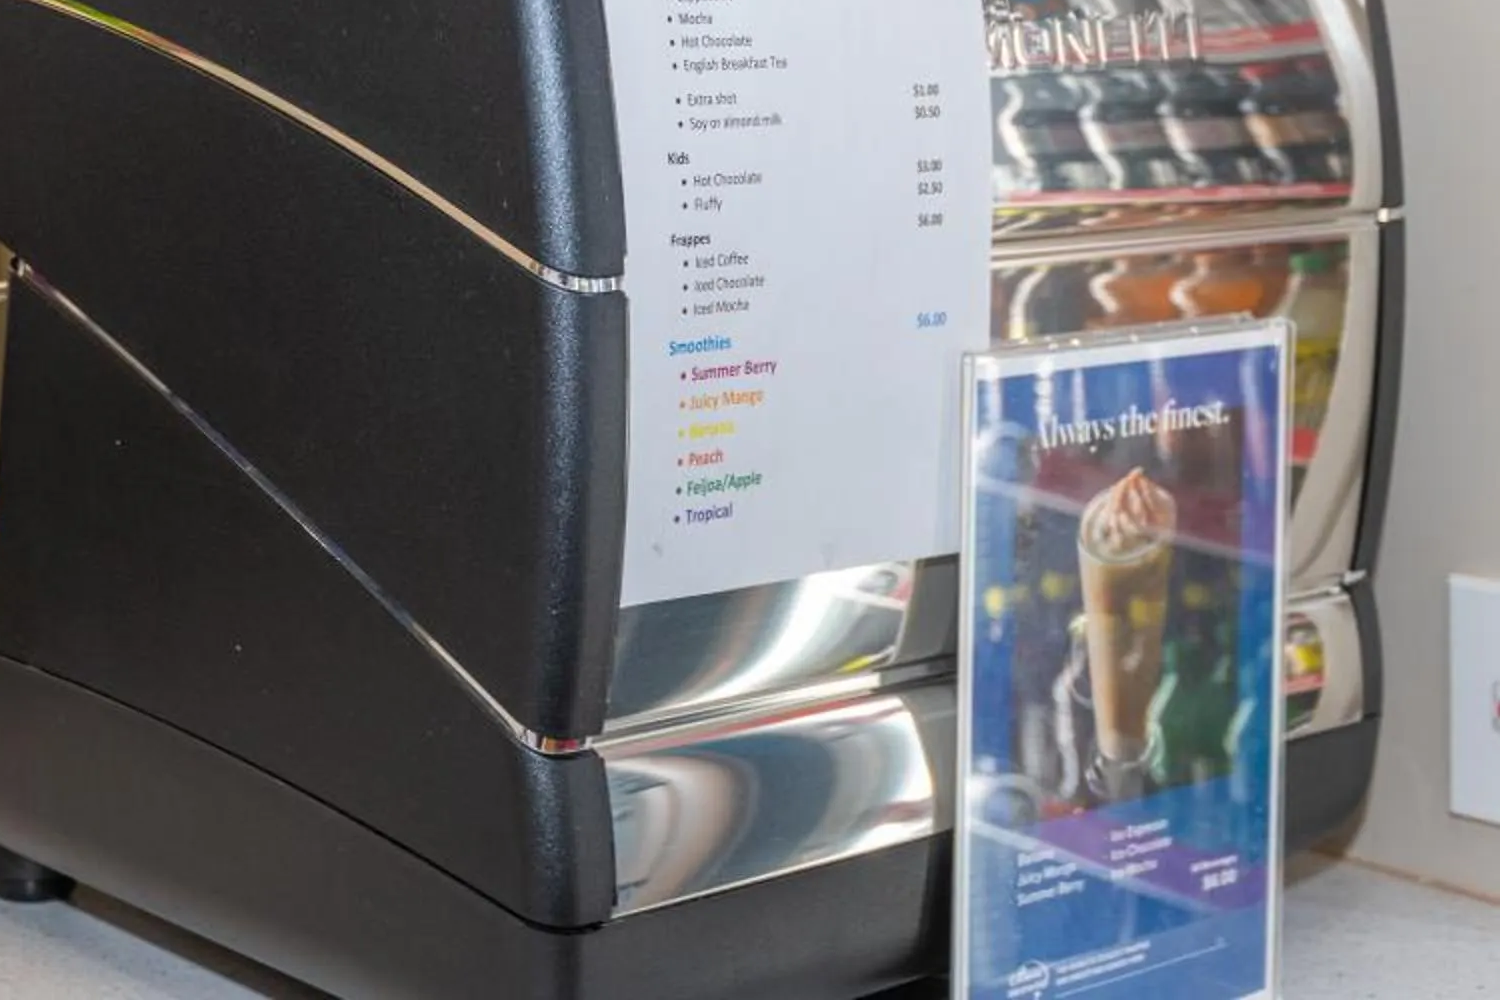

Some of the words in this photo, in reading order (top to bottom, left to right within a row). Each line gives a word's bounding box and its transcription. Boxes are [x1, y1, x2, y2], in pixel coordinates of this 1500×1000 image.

[678, 12, 713, 25] Mocha
[681, 35, 699, 48] Hot
[702, 34, 753, 48] Chocolate
[683, 58, 719, 75] English
[721, 56, 769, 71] Breakfast
[770, 55, 788, 69] Tea
[687, 93, 713, 106] Extra
[715, 92, 737, 105] shot
[689, 117, 708, 131] Soy
[723, 115, 760, 128] almond
[762, 112, 783, 126] milk
[667, 152, 690, 165] Kids
[693, 174, 711, 187] Hot
[713, 170, 763, 187] Chocolate
[694, 196, 723, 212] Fluffy
[670, 233, 711, 248] Frappes
[695, 255, 715, 269] Iced
[717, 251, 749, 267] Coffee
[694, 279, 714, 292] Iced
[715, 274, 765, 291] Chocolate
[693, 303, 714, 316] Iced
[715, 298, 750, 313] Mocha
[668, 334, 732, 356] Smoothies
[691, 364, 741, 382] Summer
[744, 359, 777, 376] Berry
[689, 394, 718, 411] Juicy
[723, 389, 765, 407] Mango
[1118, 403, 1157, 440] the
[1158, 397, 1231, 433] finest.
[689, 448, 724, 467] Peach
[686, 471, 763, 498] Feijoa/Apple
[685, 502, 734, 525] Tropical
